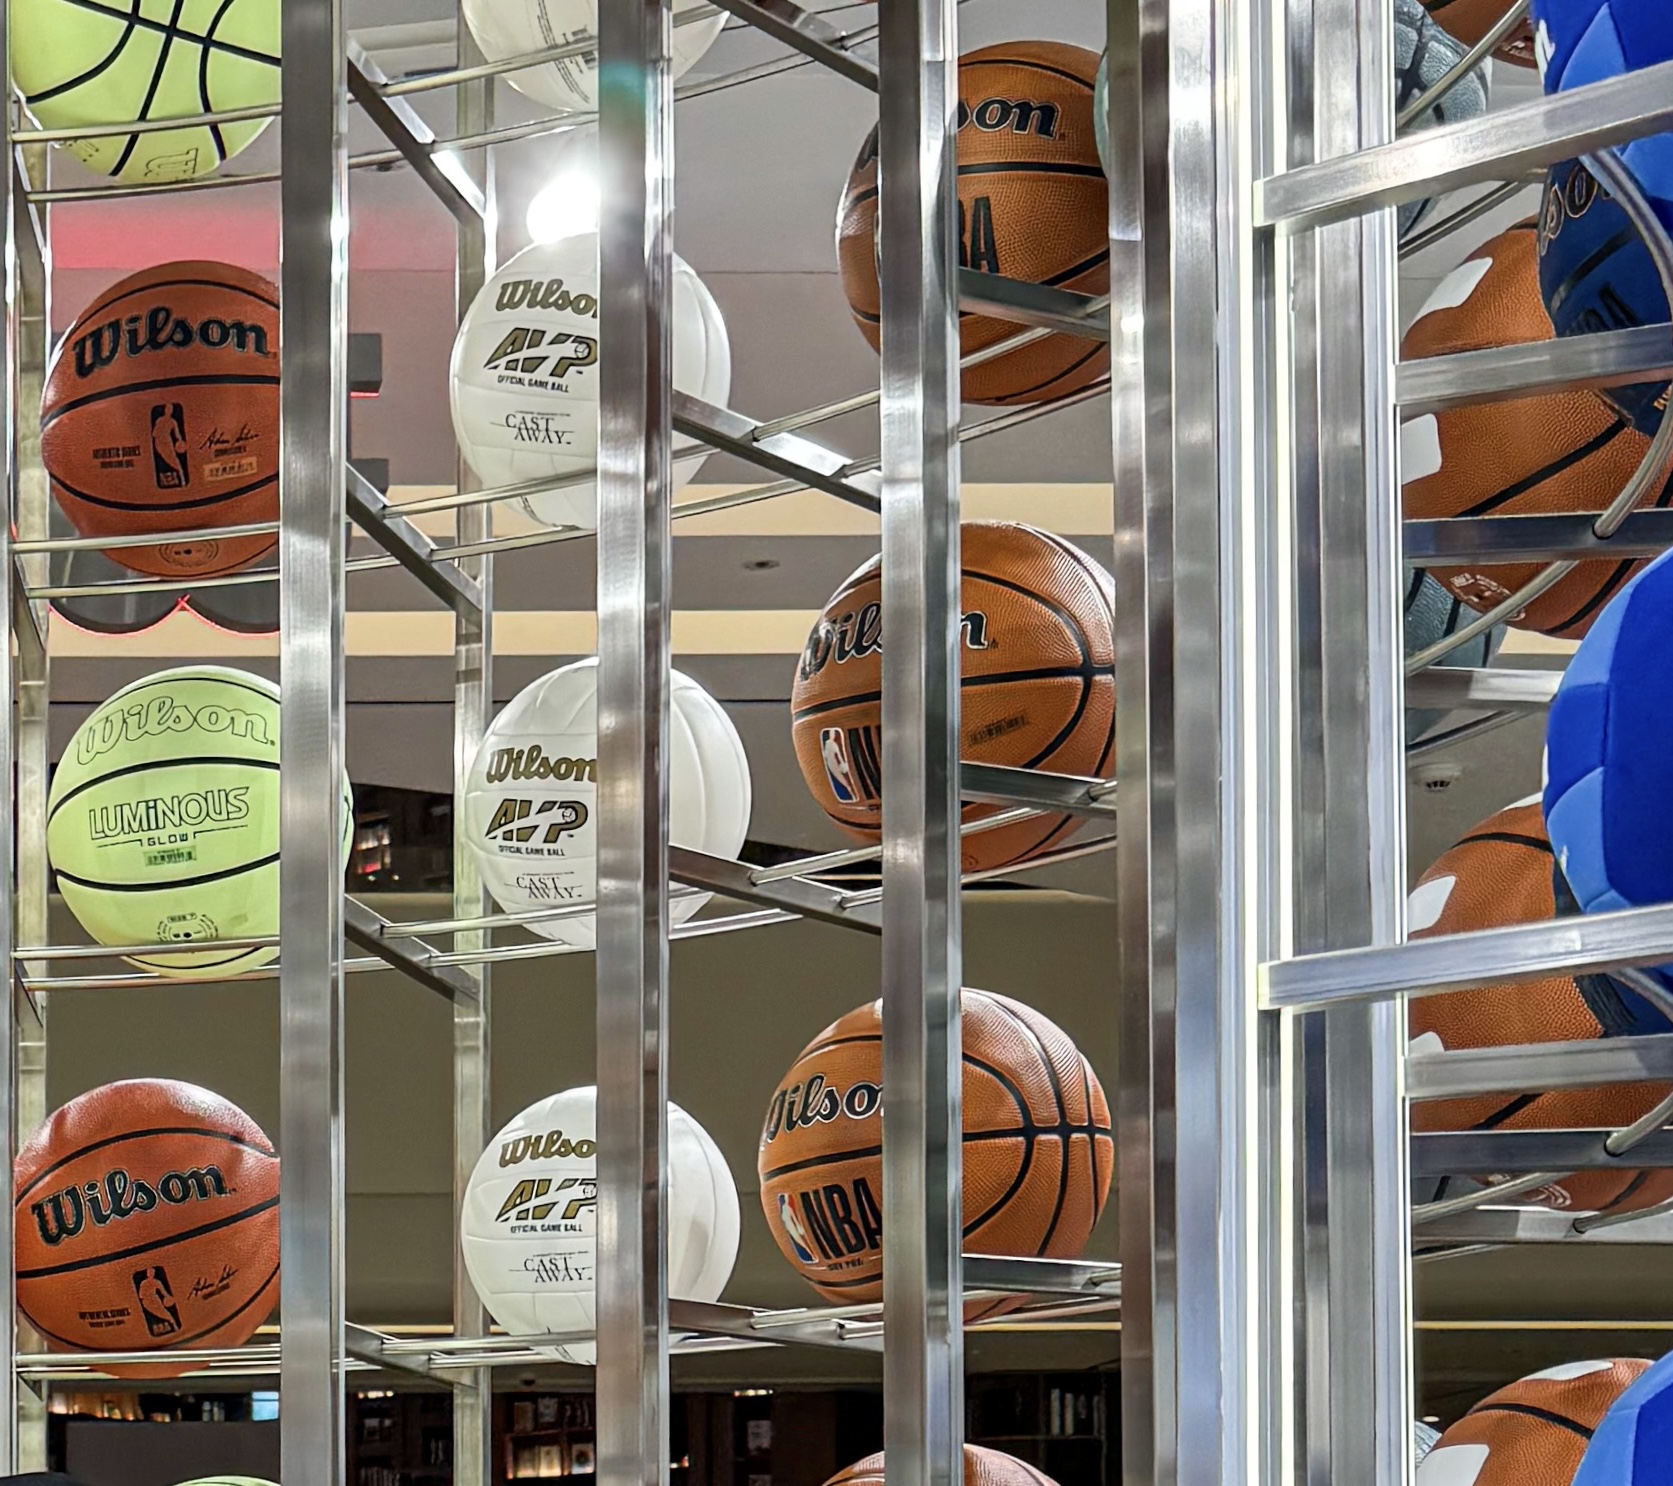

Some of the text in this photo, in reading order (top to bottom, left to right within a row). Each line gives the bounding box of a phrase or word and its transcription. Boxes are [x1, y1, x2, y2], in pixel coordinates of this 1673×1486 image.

[496, 278, 598, 318] Wilso
[73, 306, 270, 378] Wilson
[484, 327, 598, 377] AVP
[77, 696, 270, 765] Wilson
[486, 745, 597, 784] Wilson
[147, 832, 189, 847] GLOW
[485, 798, 589, 844] AVP
[762, 1073, 884, 1152] Wilso
[498, 1129, 597, 1168] Wilso
[31, 1164, 231, 1246] Wilson
[800, 1176, 882, 1260] NBA
